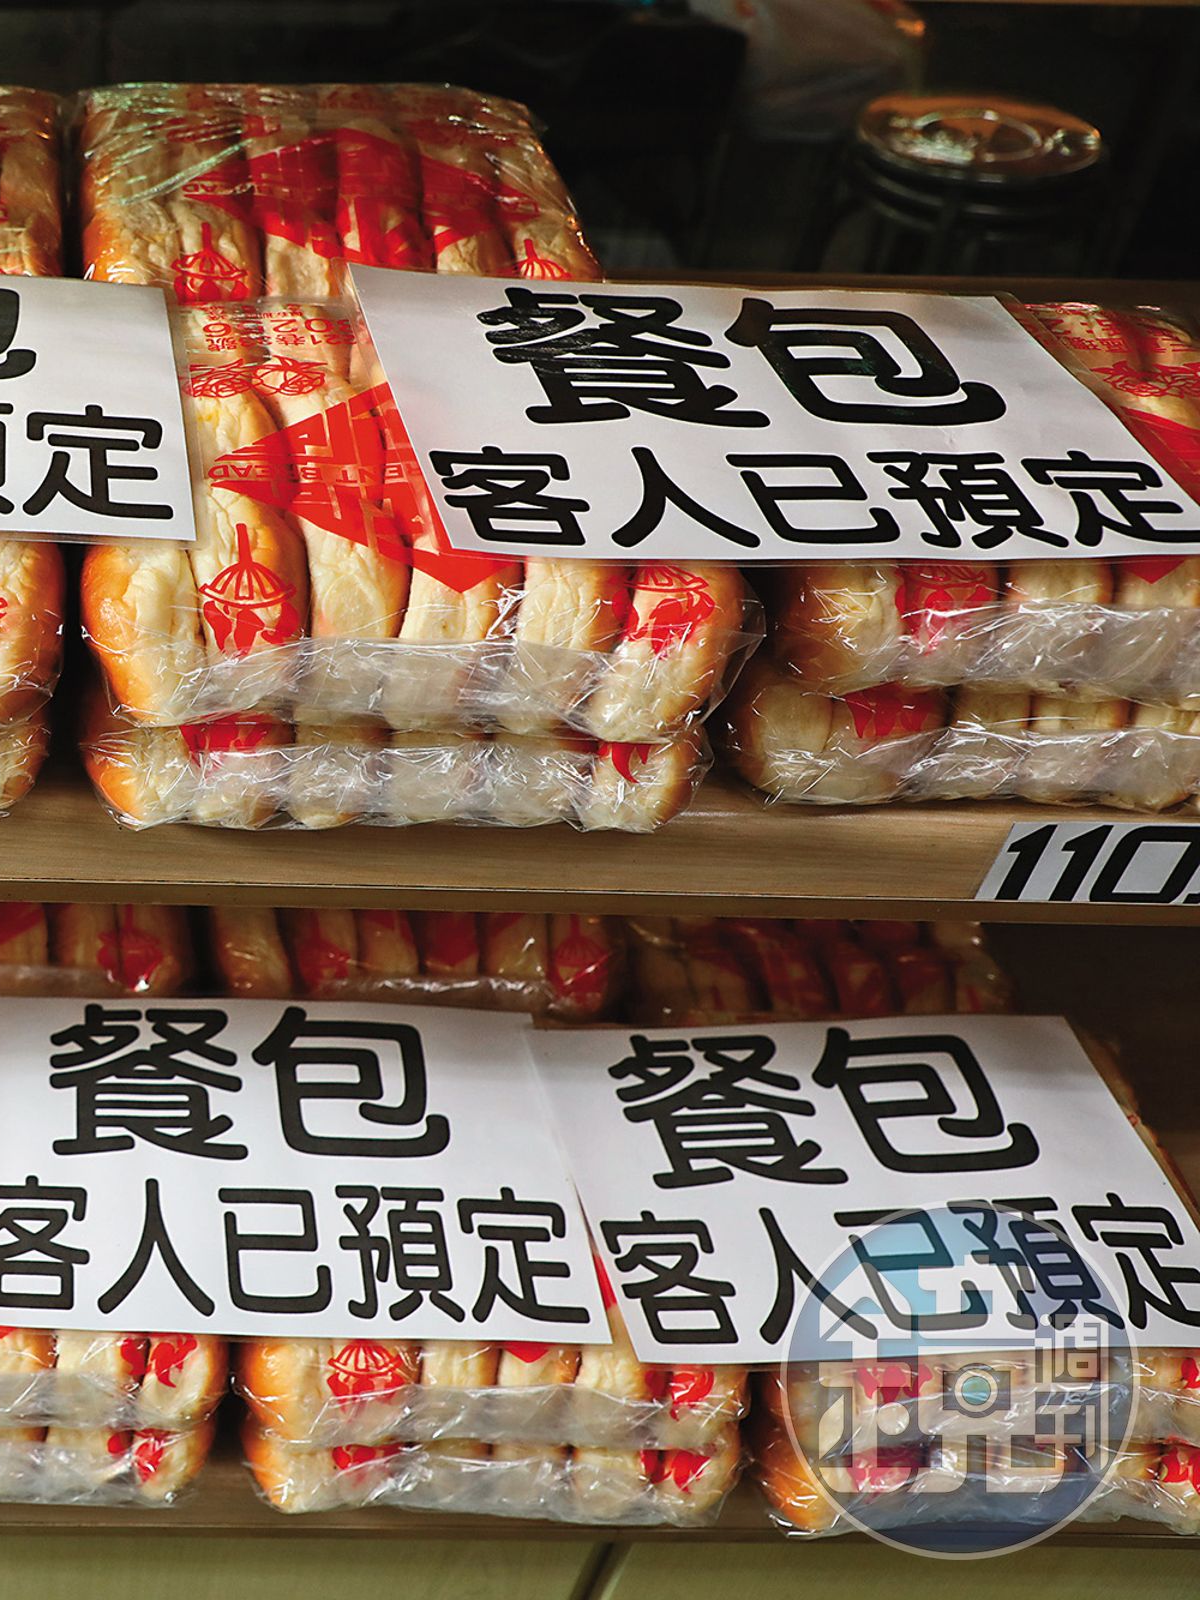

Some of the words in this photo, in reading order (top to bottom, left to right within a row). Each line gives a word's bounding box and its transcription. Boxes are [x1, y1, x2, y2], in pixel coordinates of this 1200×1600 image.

[477, 286, 1007, 428] 餐包
[207, 464, 321, 482] BEAD
[429, 446, 1200, 549] 客人已預定
[994, 824, 1200, 904] 110
[50, 1004, 451, 1160] 餐包
[608, 1027, 1040, 1189] 餐包
[600, 1192, 1200, 1344] 客人已預定
